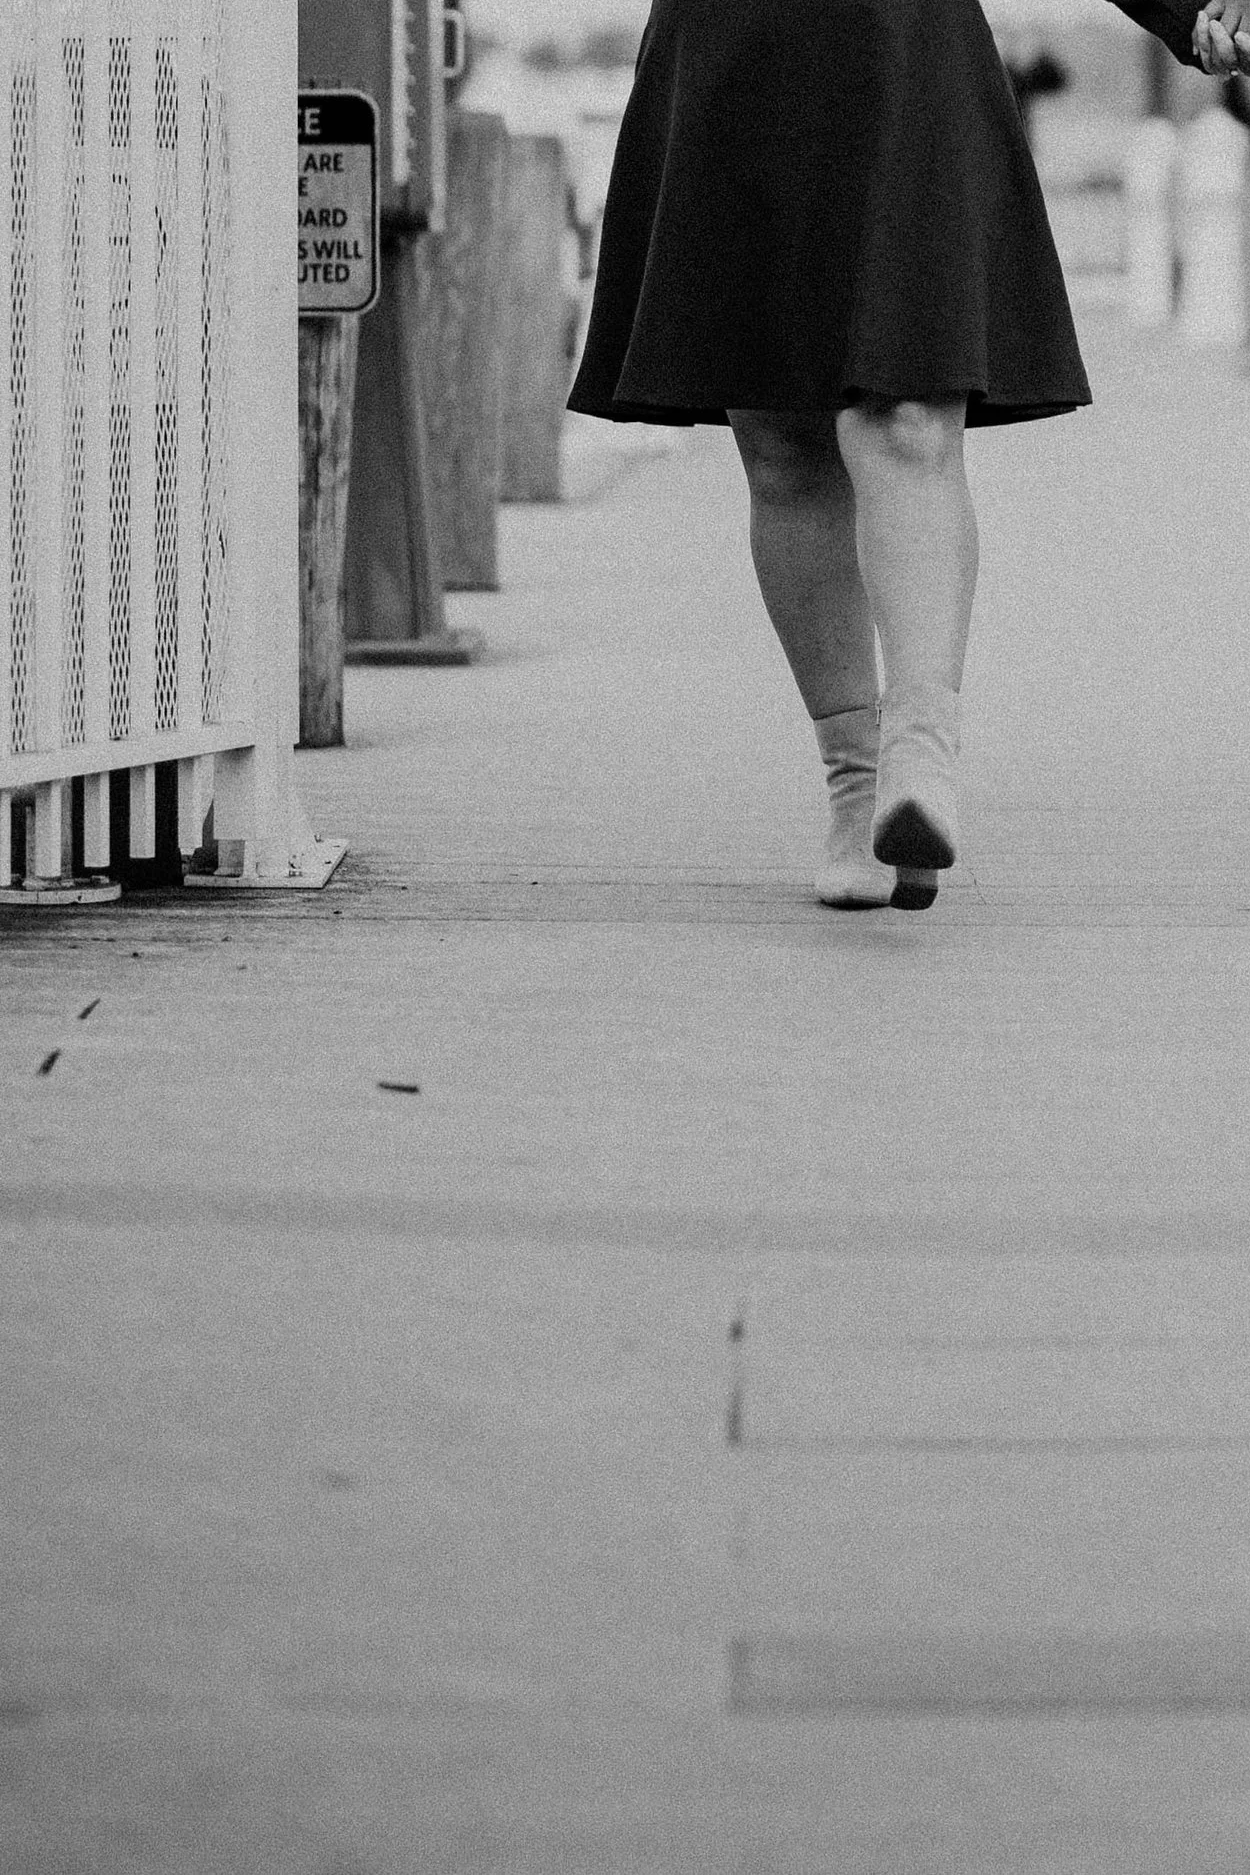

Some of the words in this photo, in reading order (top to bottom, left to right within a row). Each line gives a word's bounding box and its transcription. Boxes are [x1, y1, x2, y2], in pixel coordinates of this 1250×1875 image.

[303, 152, 345, 174] ARE
[298, 207, 348, 228] ARD
[313, 238, 363, 261] WILL
